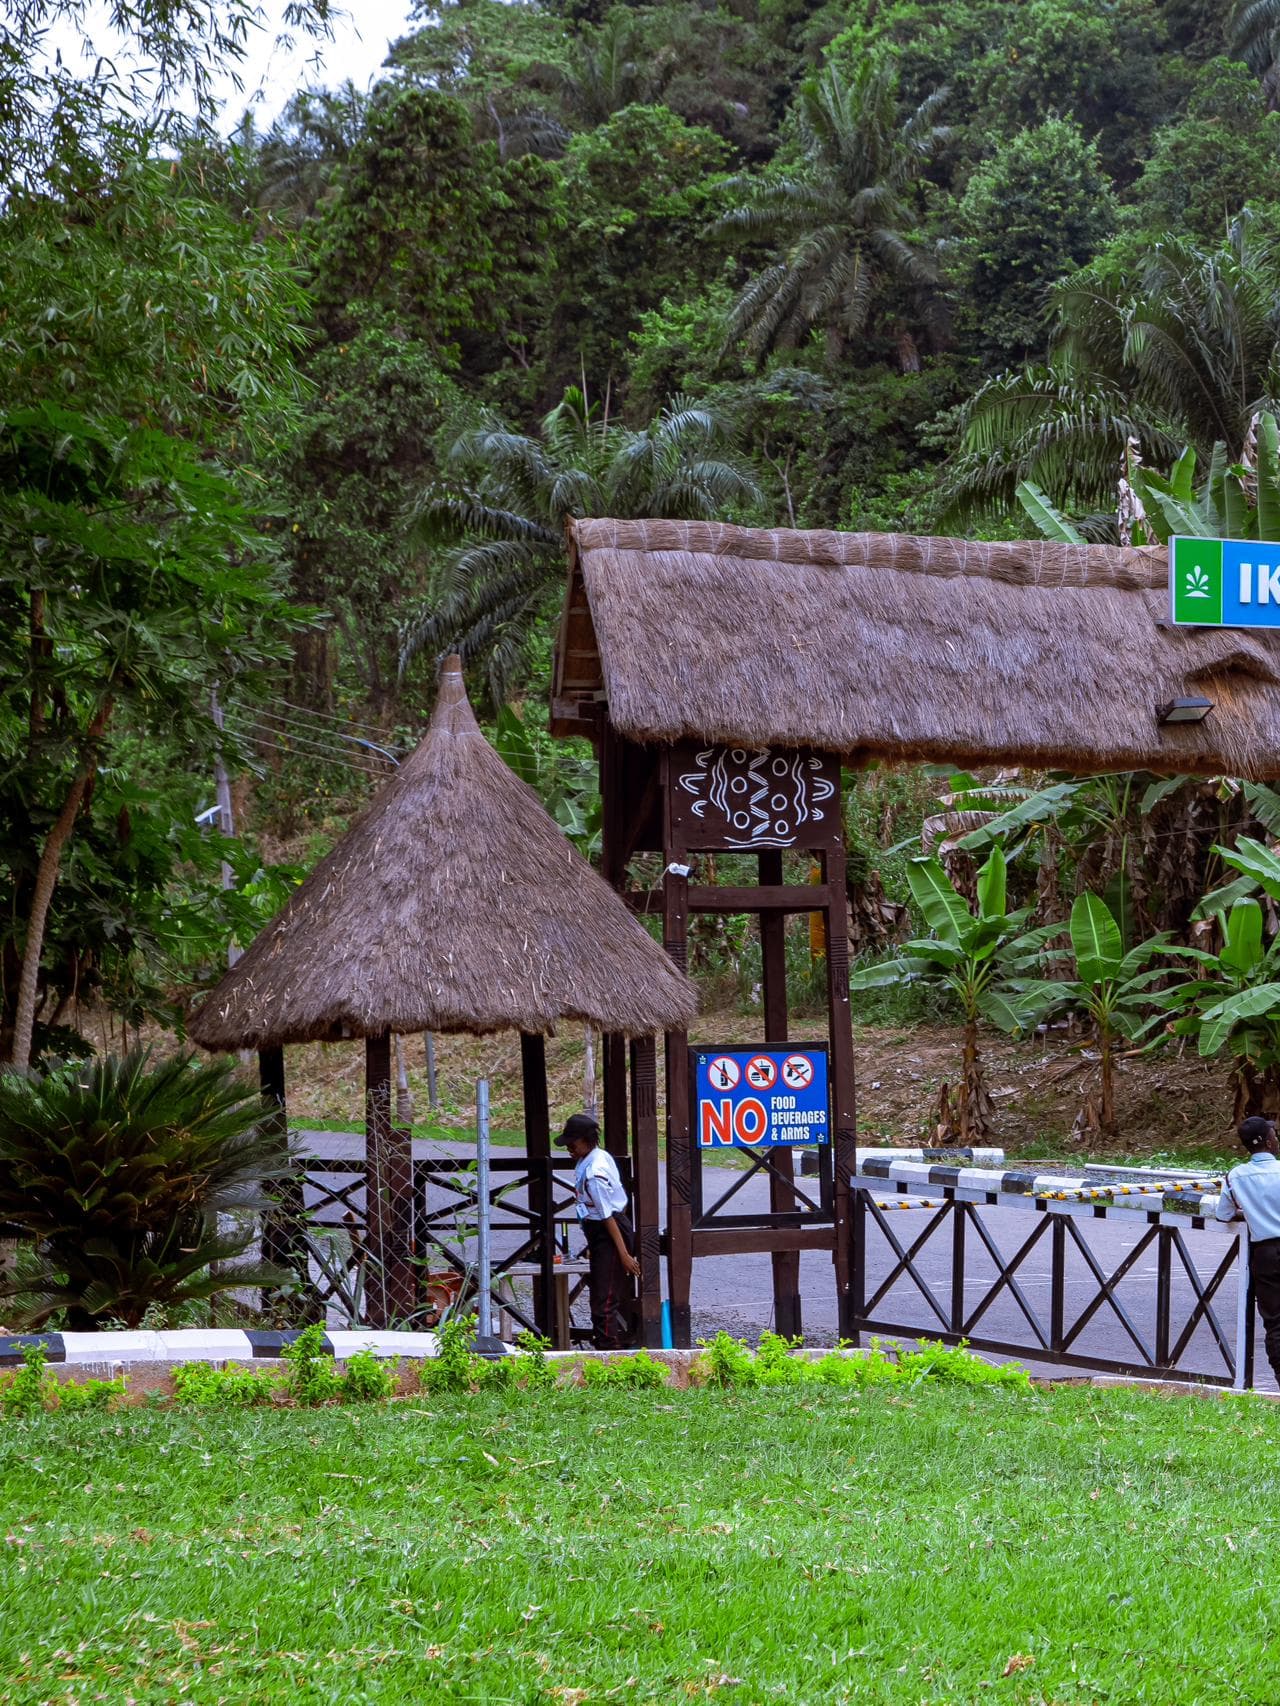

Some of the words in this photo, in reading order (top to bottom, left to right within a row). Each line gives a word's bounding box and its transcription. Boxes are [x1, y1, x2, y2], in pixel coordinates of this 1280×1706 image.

[771, 1096, 796, 1110] FOOD
[700, 1097, 768, 1145] NO
[771, 1110, 826, 1125] BEVERAGES
[771, 1127, 778, 1141] &
[781, 1126, 810, 1140] ARMS
